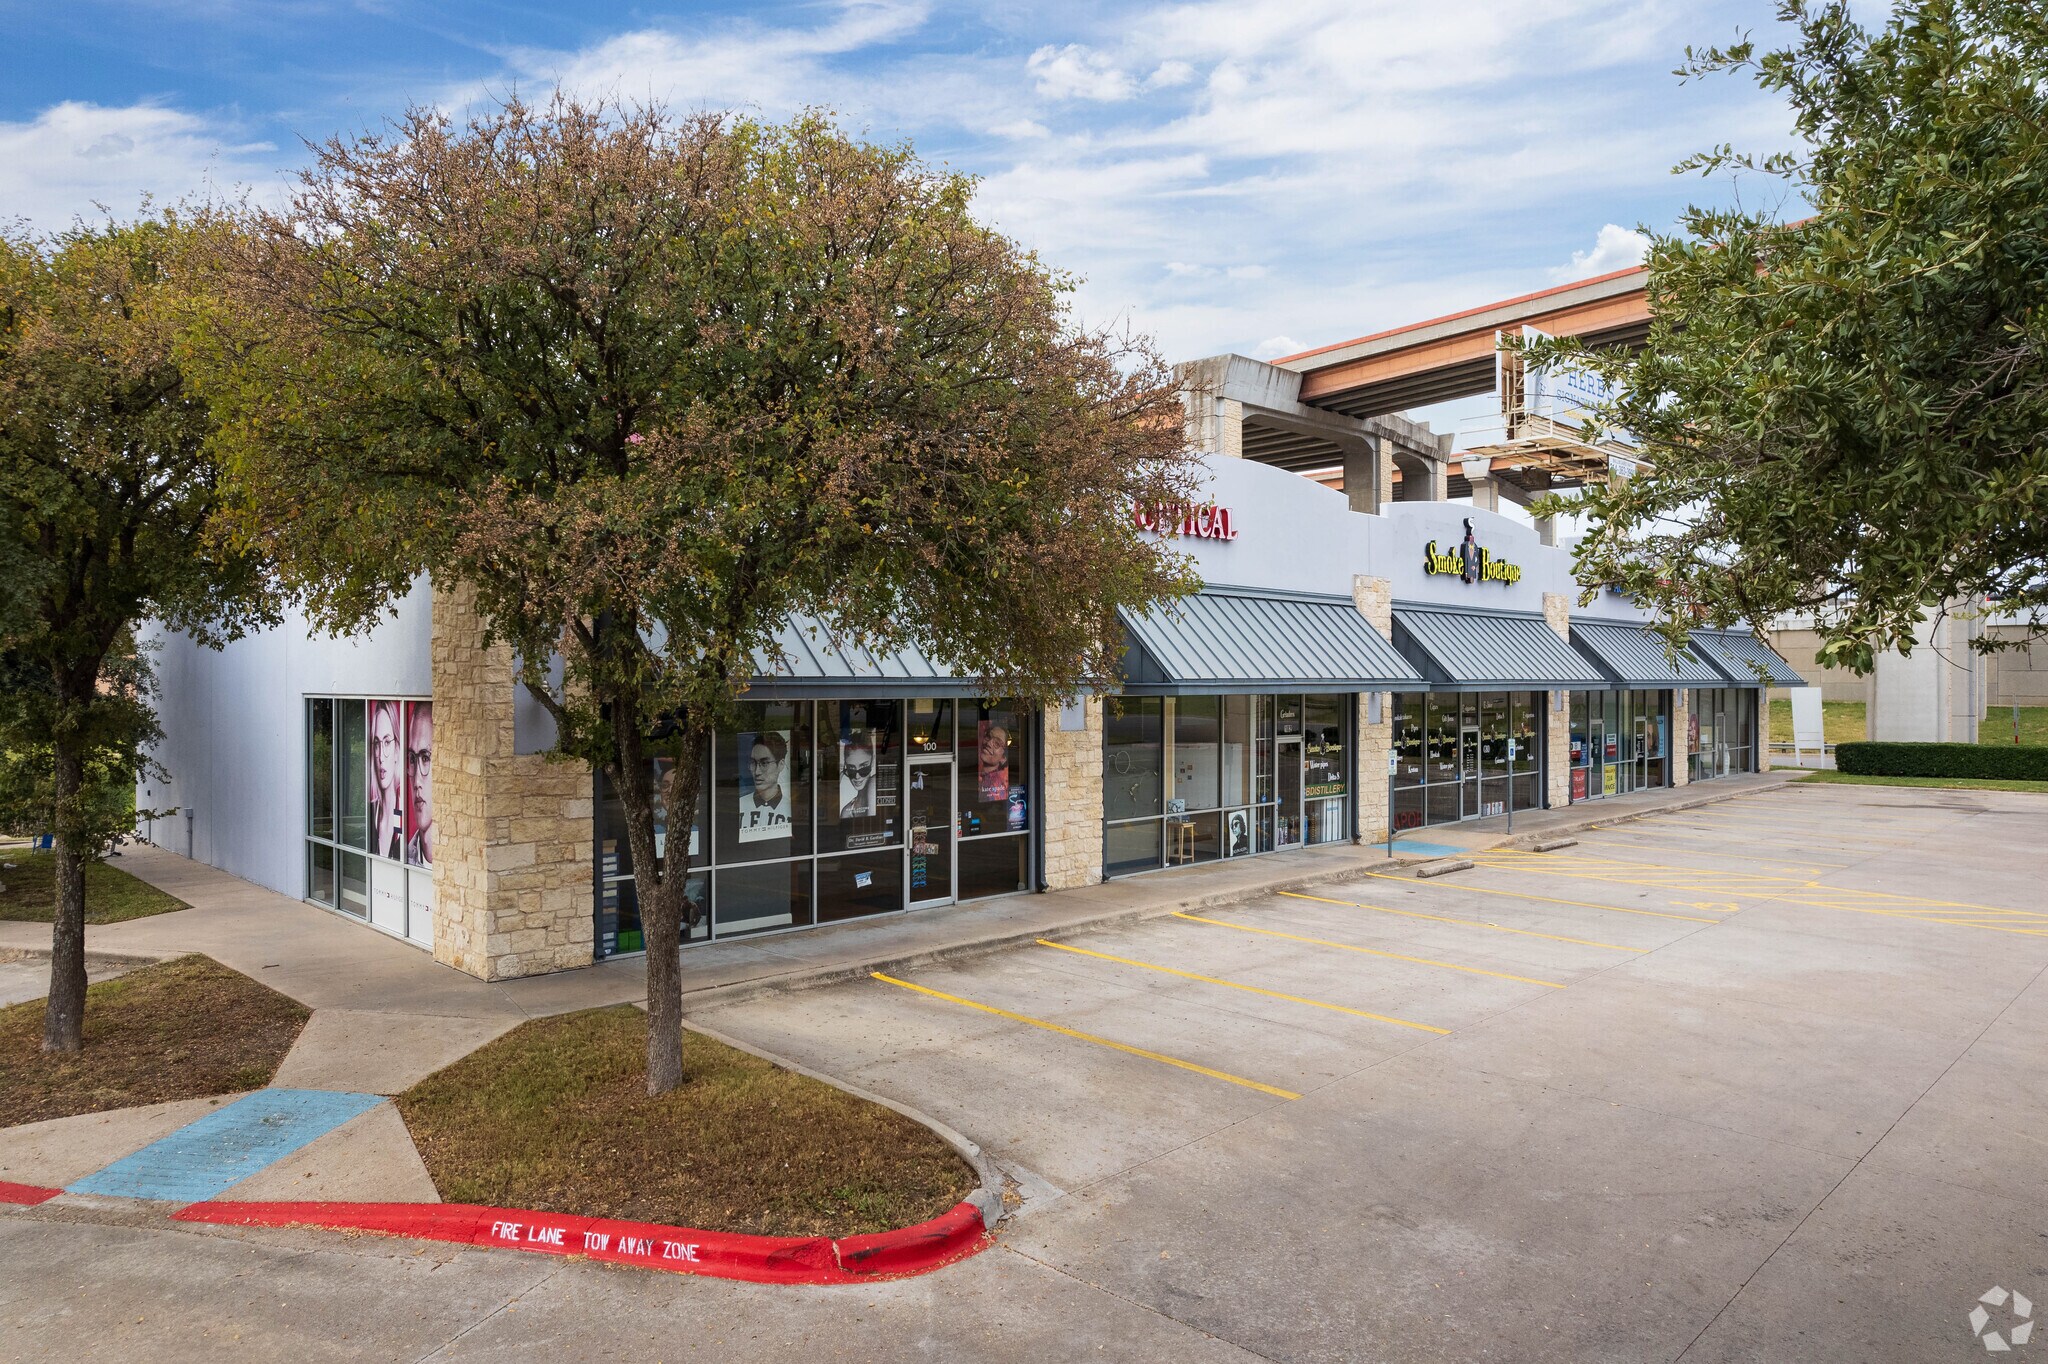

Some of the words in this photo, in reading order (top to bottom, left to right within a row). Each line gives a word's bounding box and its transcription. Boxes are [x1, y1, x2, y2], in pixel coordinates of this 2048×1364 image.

[1425, 540, 1464, 576] Smoke
[1479, 547, 1521, 586] Boutique
[923, 742, 937, 751] 100
[491, 1221, 523, 1241] FIRE
[528, 1225, 566, 1246] LANE
[584, 1231, 610, 1251] TOW
[618, 1236, 655, 1257] AWAY
[662, 1240, 701, 1263] ZONE
